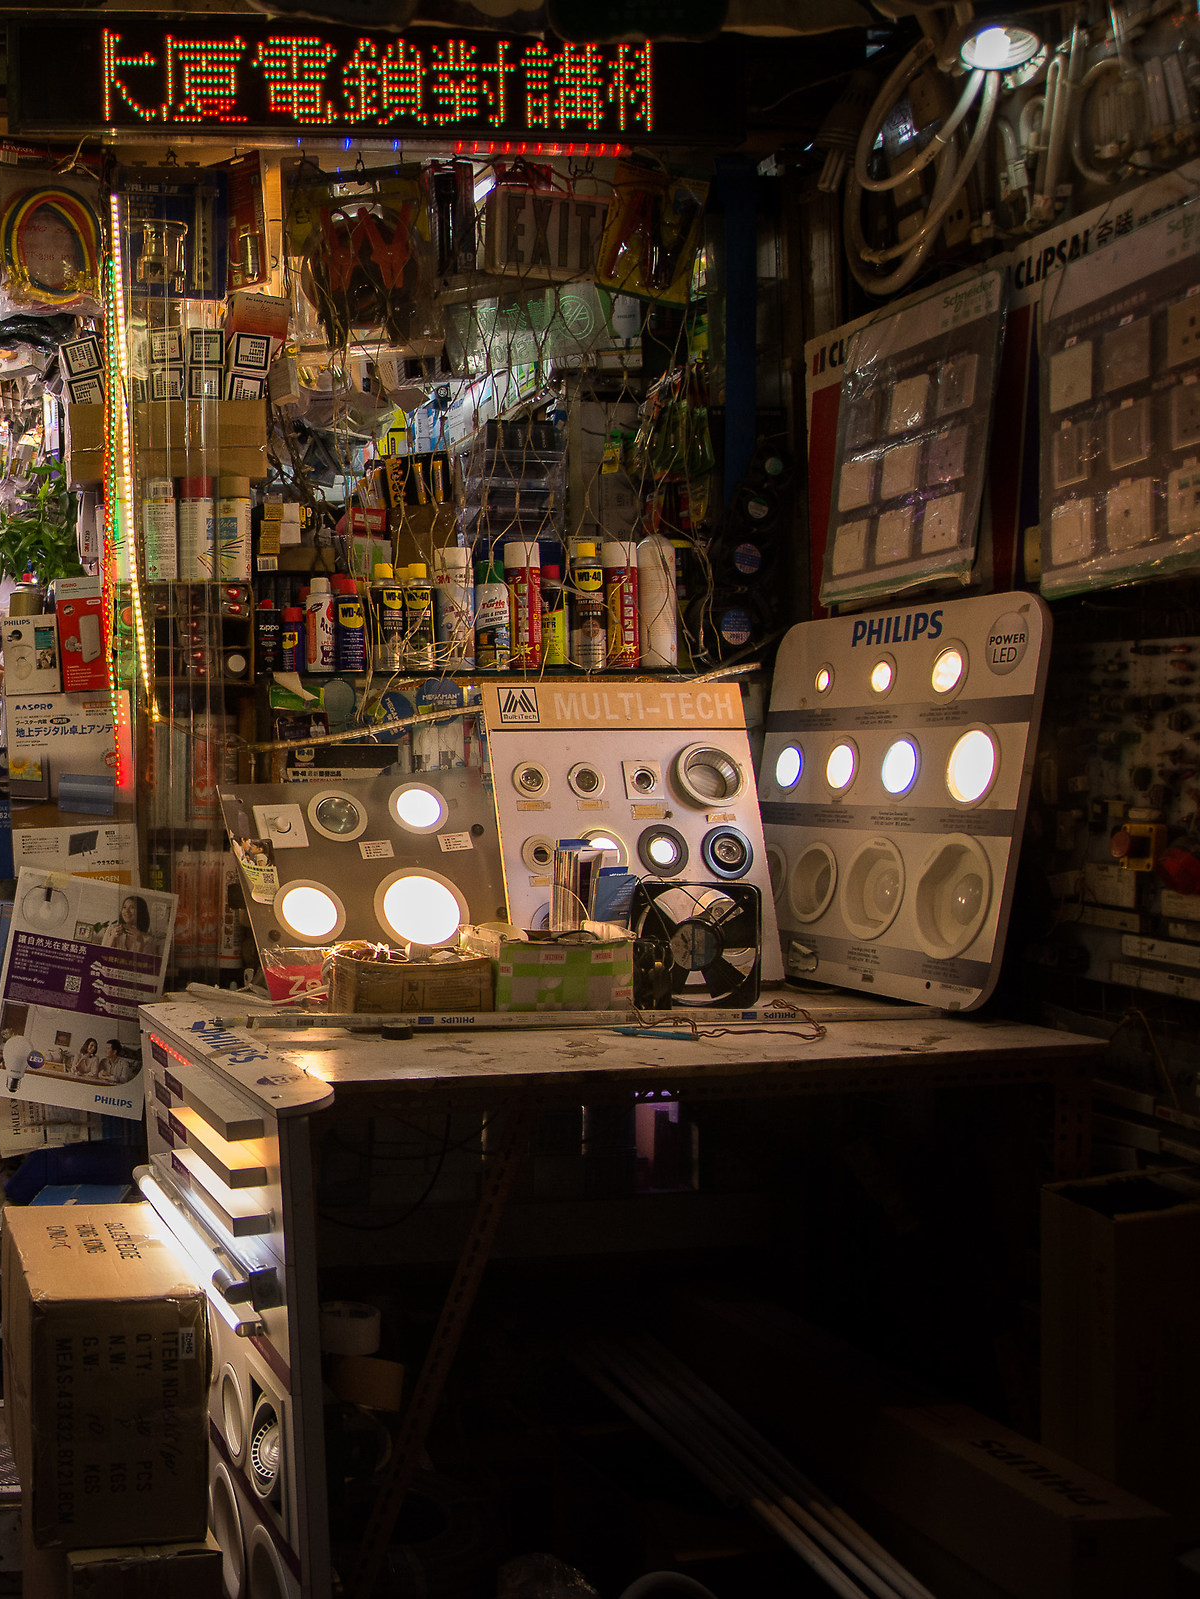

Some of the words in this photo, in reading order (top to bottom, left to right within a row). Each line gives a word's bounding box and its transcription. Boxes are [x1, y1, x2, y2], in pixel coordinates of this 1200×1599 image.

[506, 196, 596, 269] EXIT
[577, 571, 603, 582] WD-40
[3, 619, 31, 627] PHILIPS
[259, 624, 280, 633] zippo
[851, 610, 944, 648] PHILIPS
[988, 633, 1026, 646] POWER
[992, 647, 1018, 664] LED
[554, 692, 735, 721] MULTI-TECH
[17, 934, 88, 955] 讓自然光在家點亮
[441, 1016, 475, 1024] PHILIPS
[94, 1094, 133, 1109] PHILIPS
[162, 1331, 178, 1372] ITEM
[84, 1464, 101, 1495] KGS
[110, 1462, 127, 1493] KGS
[136, 1460, 153, 1492] PCS
